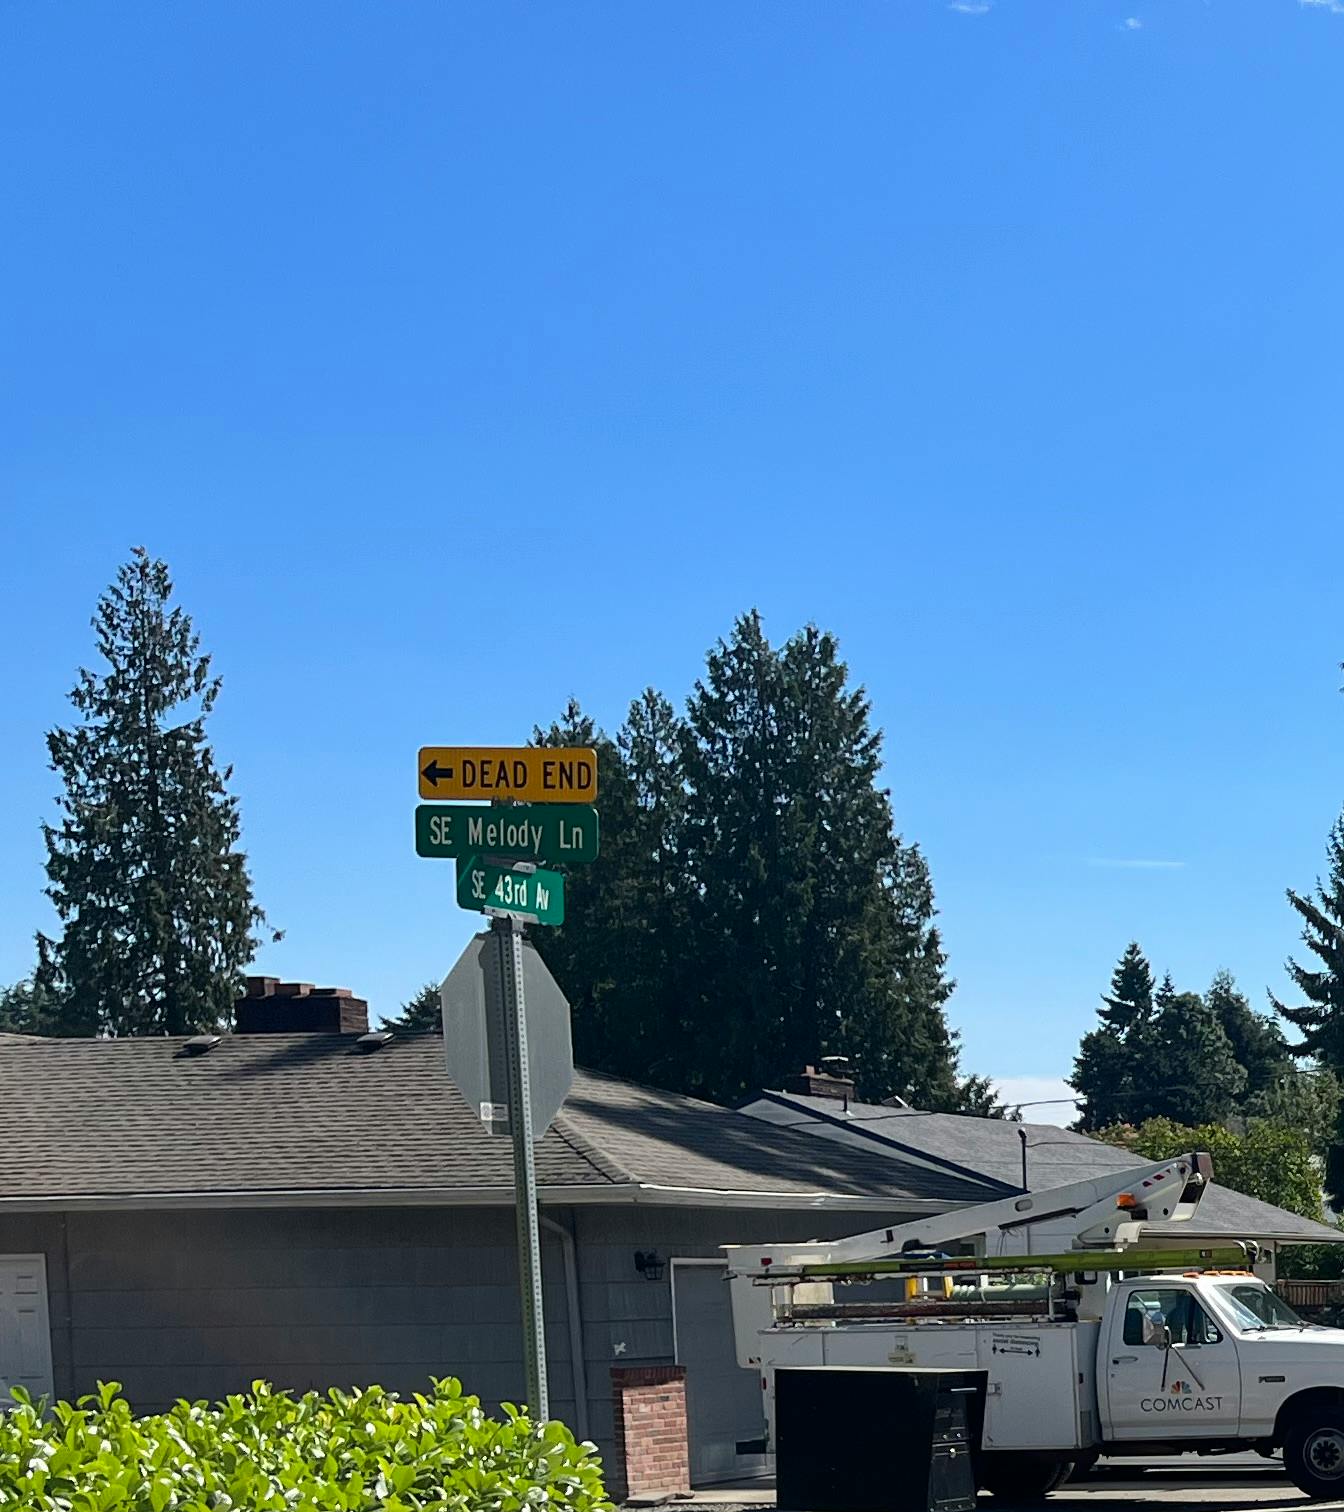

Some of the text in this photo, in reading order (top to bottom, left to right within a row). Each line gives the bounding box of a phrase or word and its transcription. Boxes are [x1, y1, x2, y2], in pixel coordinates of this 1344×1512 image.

[461, 759, 593, 790] DEAD END
[429, 815, 584, 855] SE Melody Ln
[471, 869, 550, 911] SE 43rd Av
[1140, 1396, 1224, 1413] COMCAST
